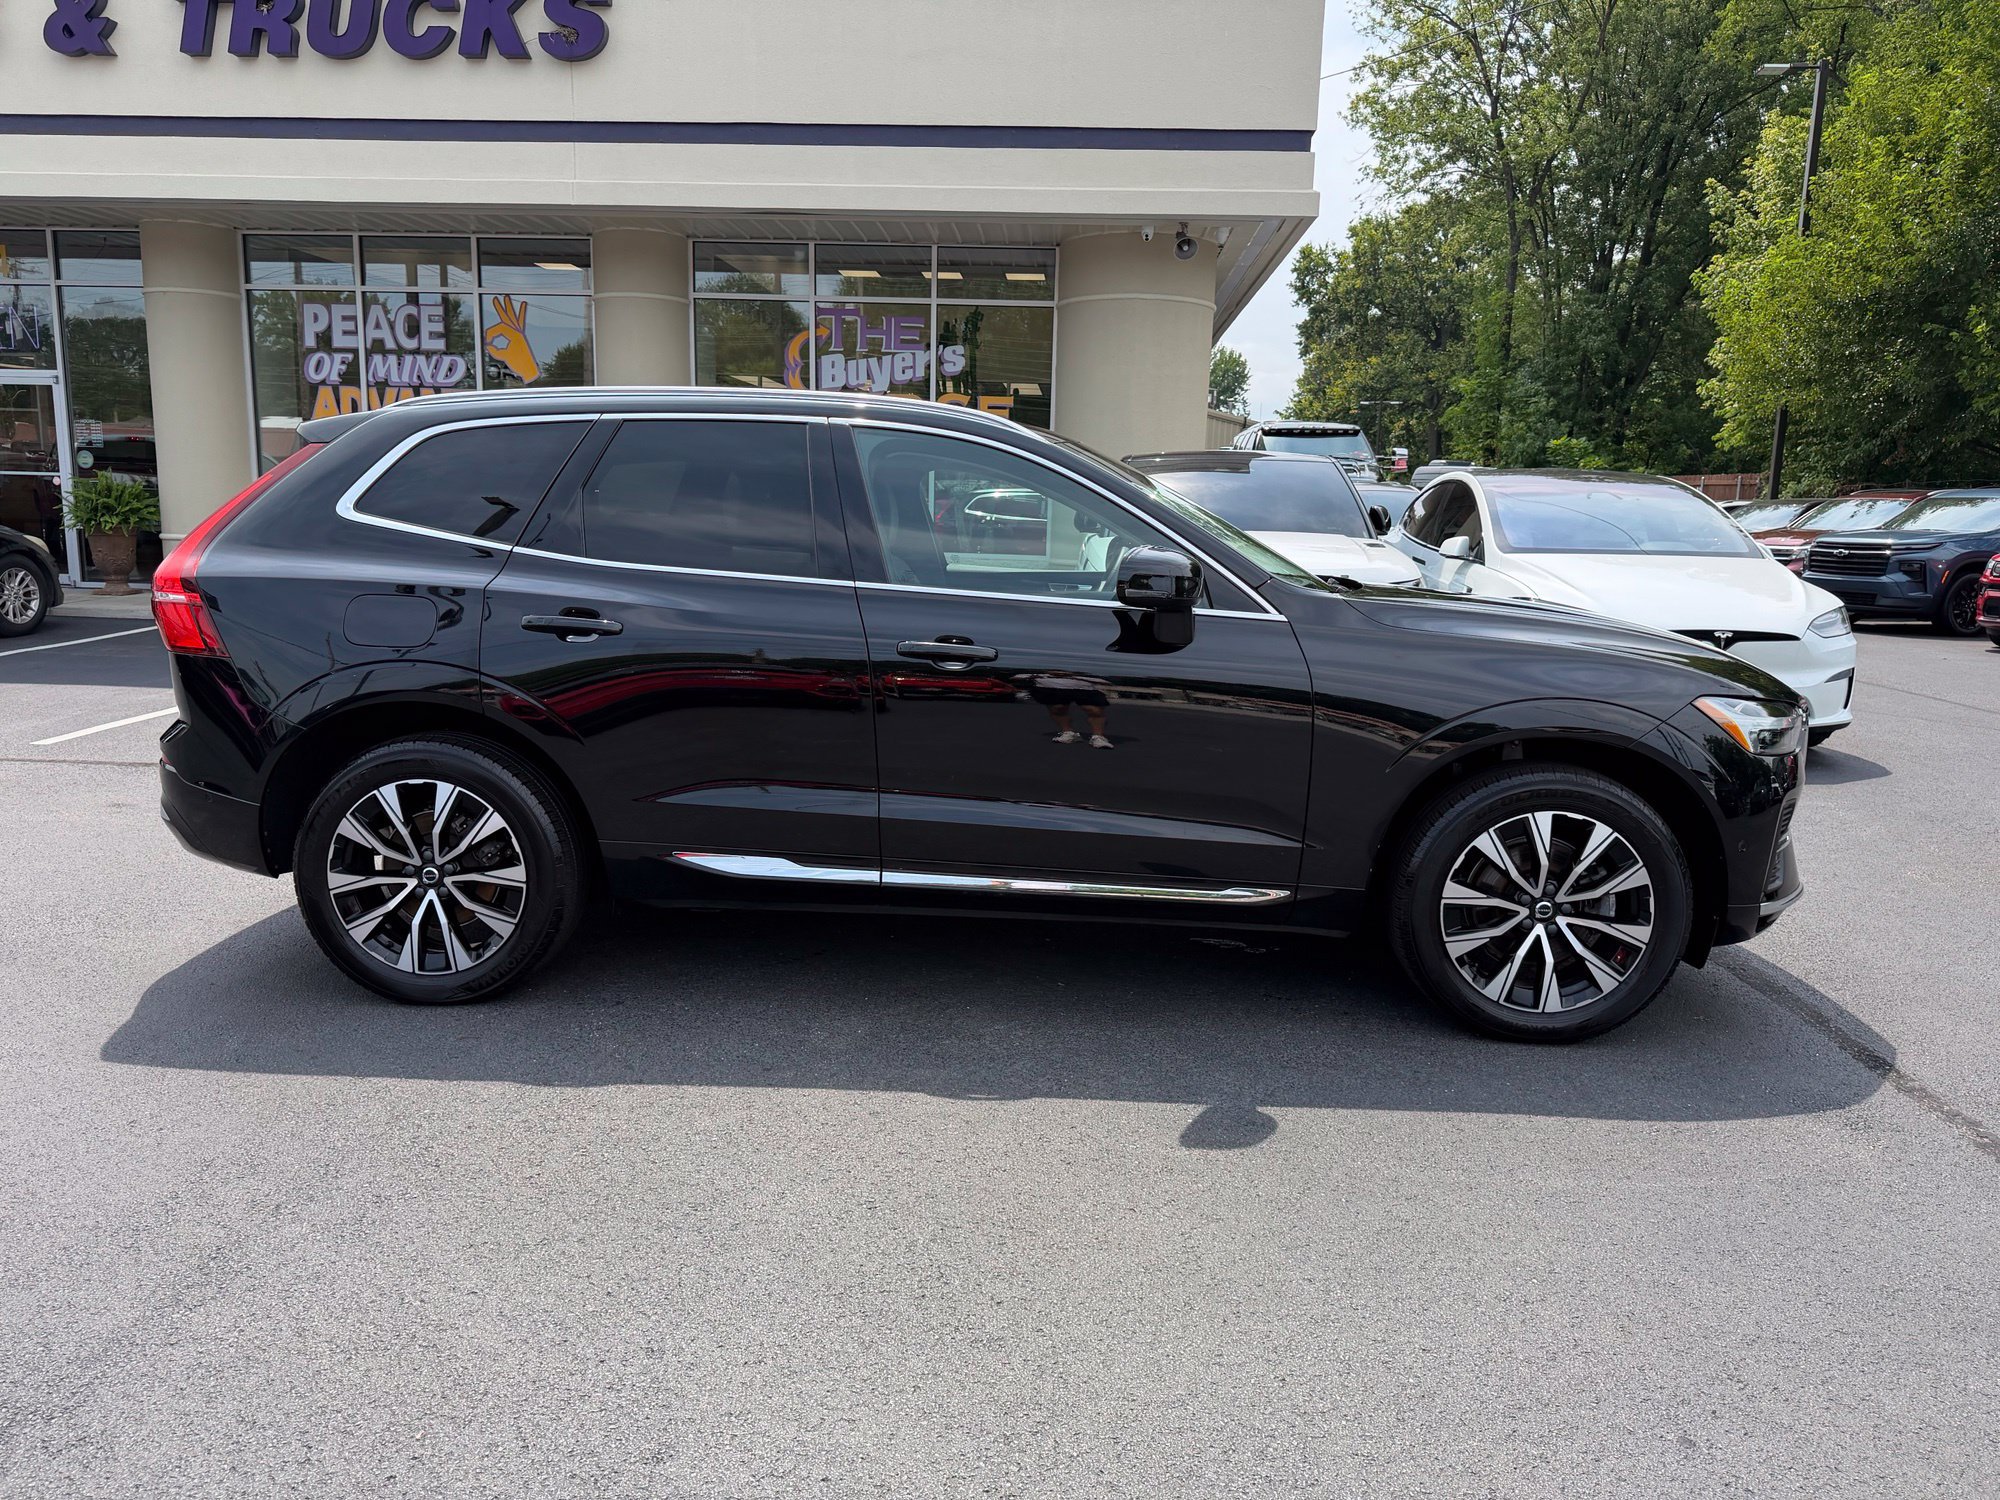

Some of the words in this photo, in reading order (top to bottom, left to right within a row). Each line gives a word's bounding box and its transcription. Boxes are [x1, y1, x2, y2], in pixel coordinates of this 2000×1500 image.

[43, 0, 118, 57] &
[178, 0, 613, 62] TRUCKS
[302, 303, 447, 350] PEACE
[816, 306, 926, 352] THE
[303, 352, 354, 385] OF
[367, 353, 468, 388] MIND
[819, 344, 967, 394] Buyer's
